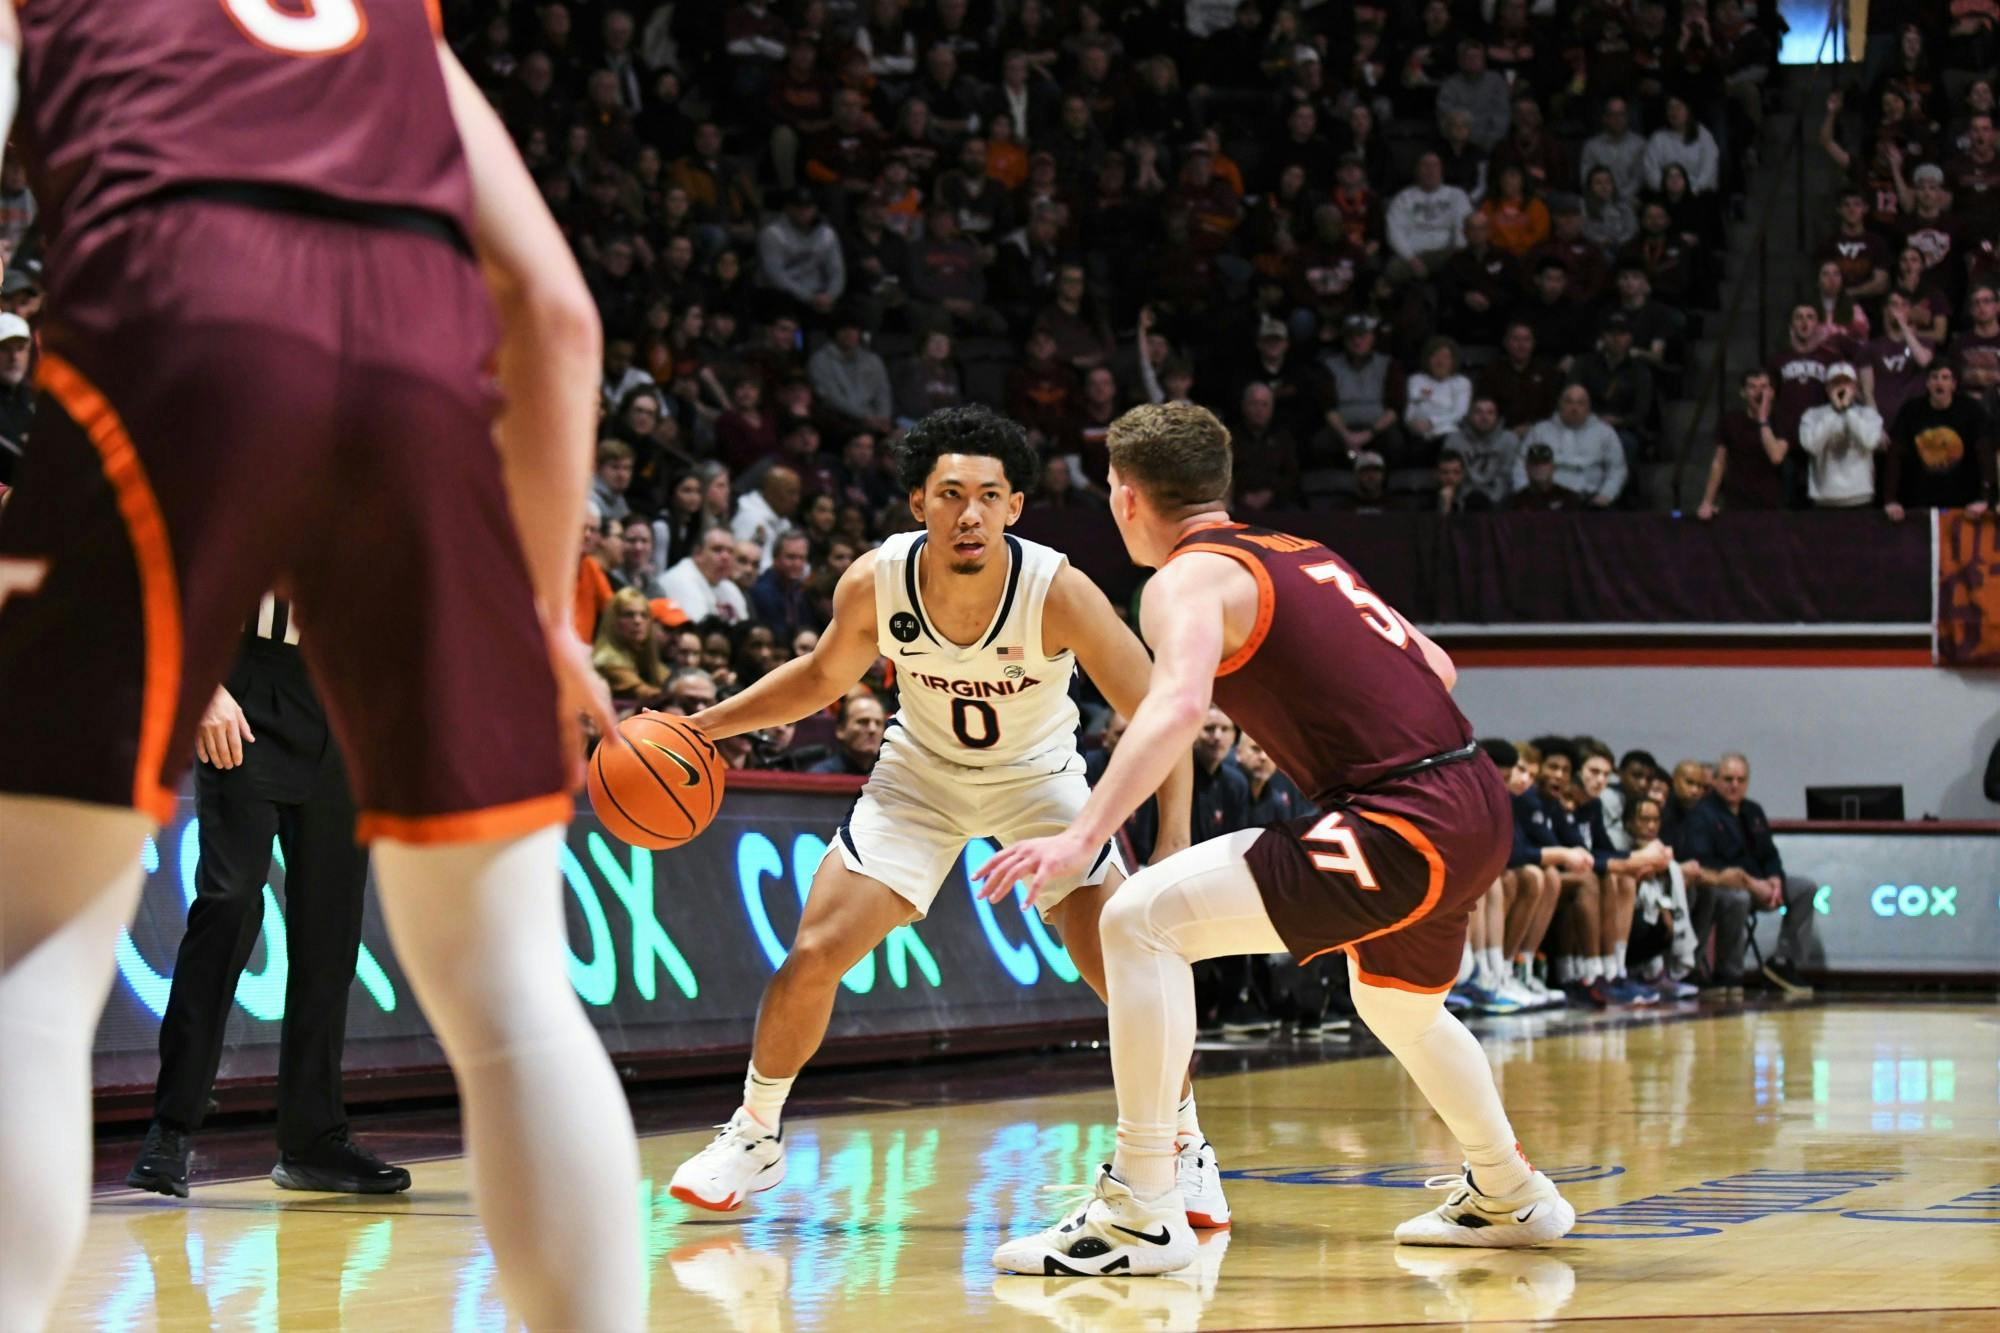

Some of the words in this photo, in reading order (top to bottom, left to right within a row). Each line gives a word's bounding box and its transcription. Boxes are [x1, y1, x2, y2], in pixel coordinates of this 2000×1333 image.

[1299, 560, 1409, 650] 3
[951, 697, 1001, 749] 0
[557, 831, 699, 1006] OX
[1870, 884, 1958, 917] COX
